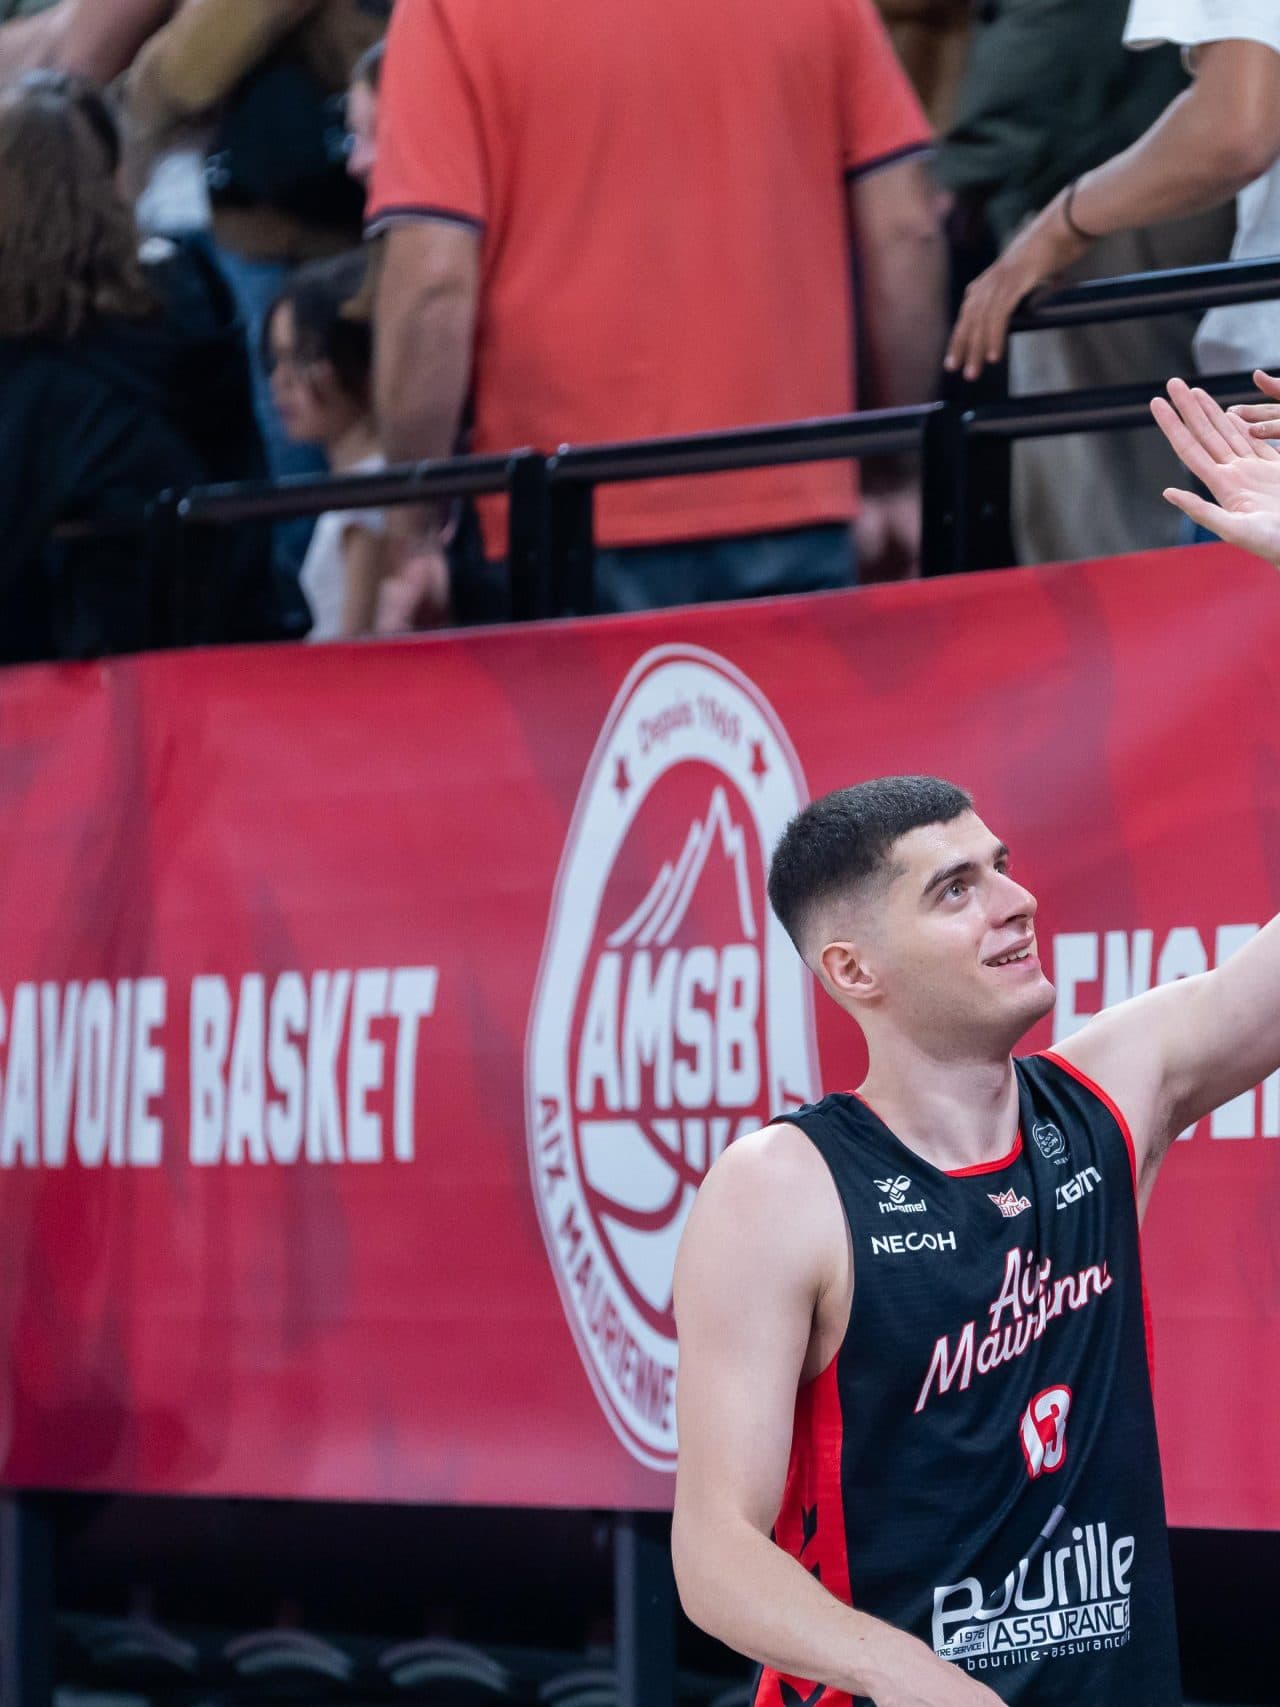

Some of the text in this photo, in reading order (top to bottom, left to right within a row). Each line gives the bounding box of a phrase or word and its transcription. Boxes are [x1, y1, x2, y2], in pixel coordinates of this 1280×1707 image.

[0, 966, 438, 1168] AVOIE BASKET
[577, 945, 762, 1111] AMSB
[540, 1097, 567, 1195] AIX
[871, 1231, 957, 1254] NECOH
[1018, 1384, 1072, 1481] 13
[958, 1629, 985, 1644] 1976
